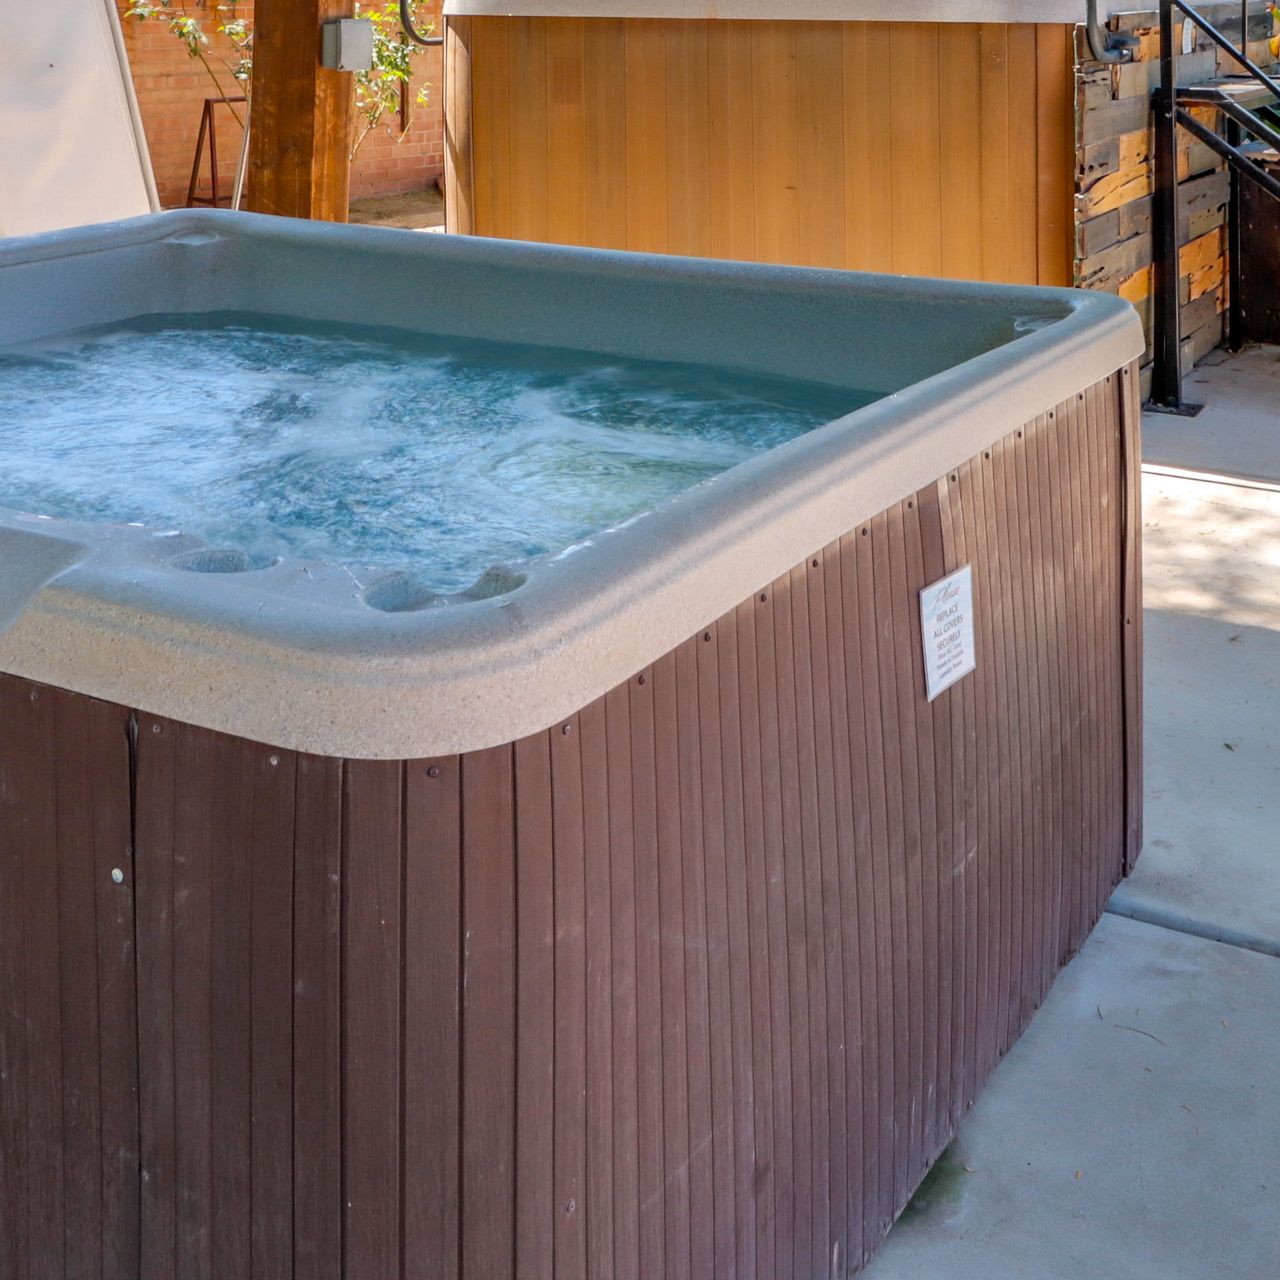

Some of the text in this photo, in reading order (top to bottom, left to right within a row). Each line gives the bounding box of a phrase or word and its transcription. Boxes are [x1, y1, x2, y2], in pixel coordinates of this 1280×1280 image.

[936, 603, 959, 623] REPLACE
[933, 614, 963, 640] ALL COVERS
[937, 630, 961, 652] SECURELY
